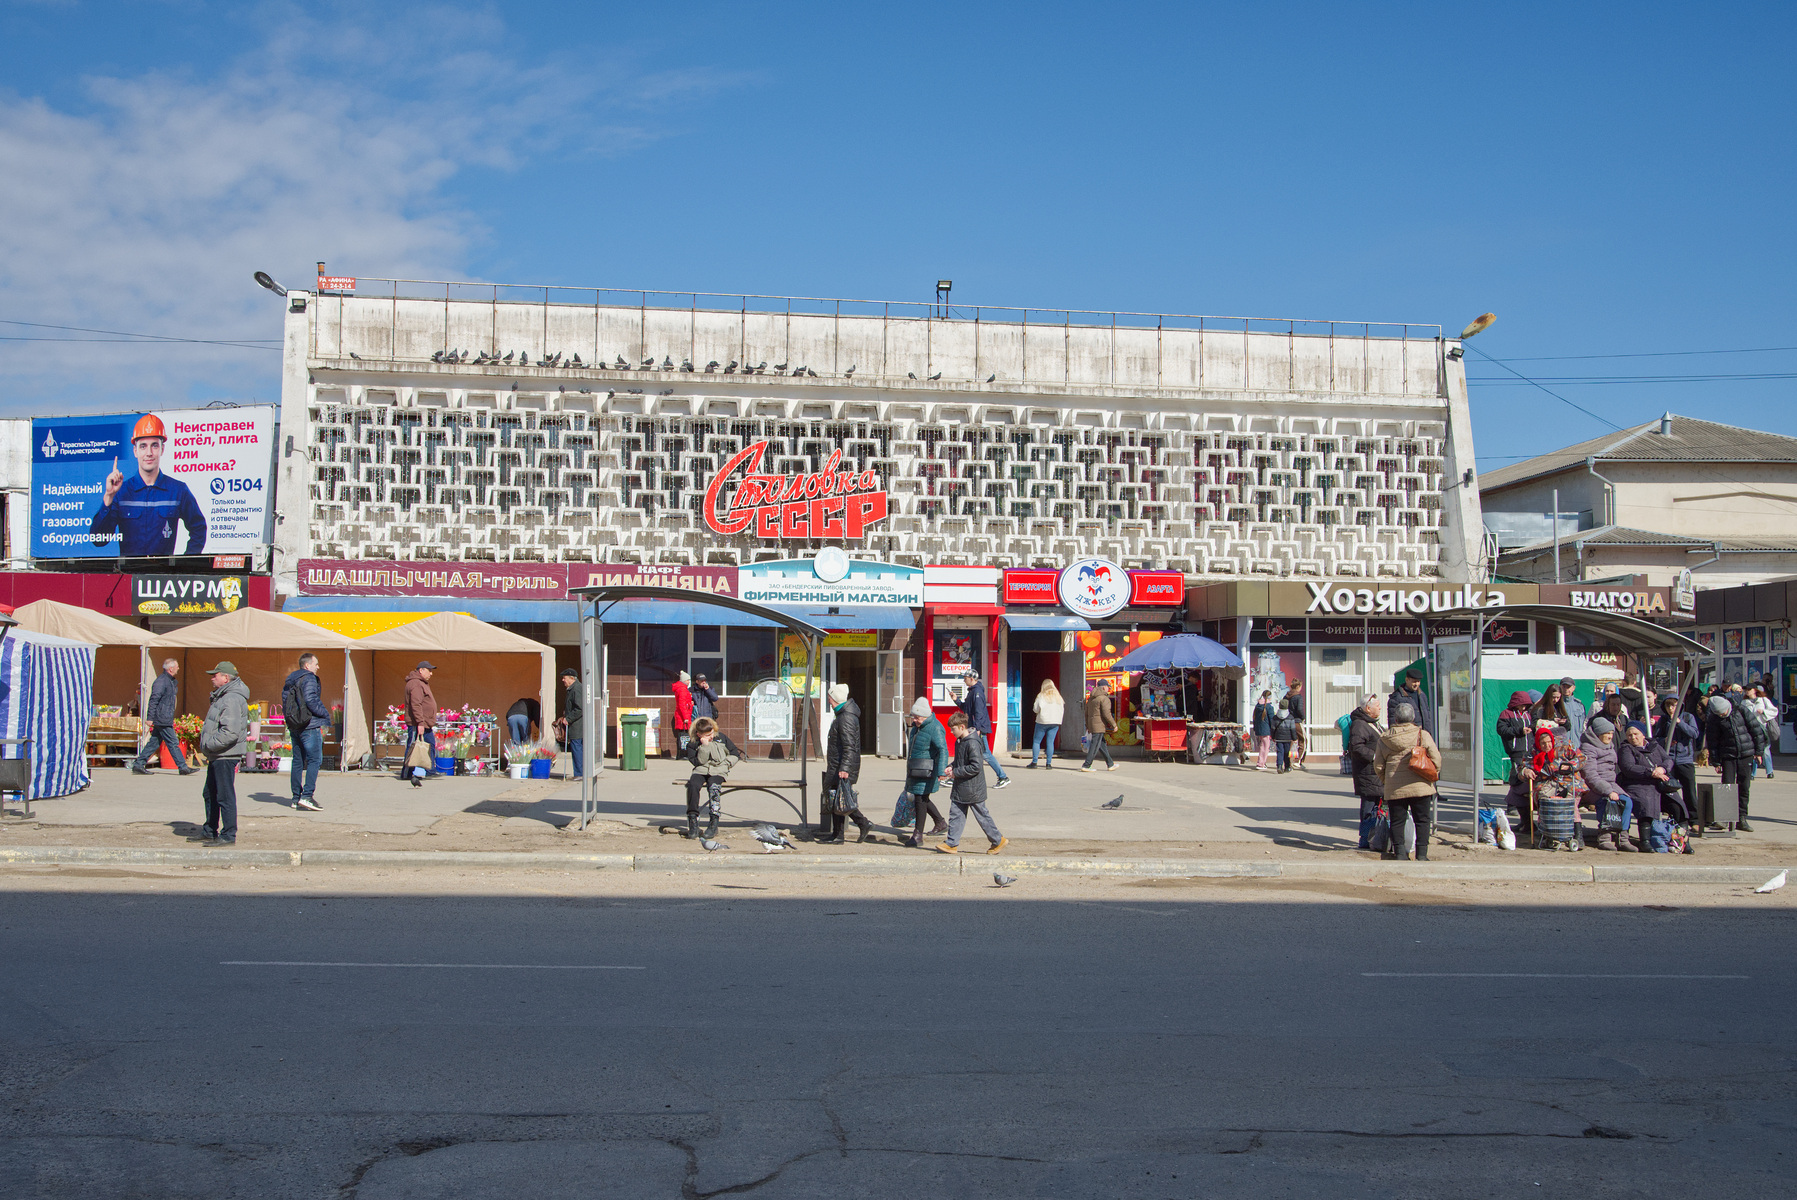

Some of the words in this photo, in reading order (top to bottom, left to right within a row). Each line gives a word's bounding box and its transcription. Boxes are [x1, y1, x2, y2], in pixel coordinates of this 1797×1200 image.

[174, 421, 255, 435] Неисправен
[174, 434, 216, 447] котёл,
[218, 434, 259, 445] плита
[60, 448, 105, 456] Приднестровье
[173, 450, 199, 460] или
[173, 459, 237, 473] колонка?
[43, 482, 103, 496] Надёжный
[227, 478, 263, 492] 1504
[703, 440, 877, 535] Столовка
[42, 501, 85, 514] ремонт
[757, 490, 888, 539] СССР
[42, 517, 92, 528] газового
[42, 532, 123, 546] оборудования
[210, 531, 260, 539] безопасность!
[637, 565, 682, 575] КАФЕ
[307, 568, 559, 592] ШАШЛЫЧНАЯ-гриль
[138, 579, 243, 598] ШАУРМА
[1009, 583, 1052, 592] ТЕРРИТОРИЯ
[1146, 584, 1175, 593] АЗАРТА
[744, 590, 844, 603] ФИРМЕННЫЙ
[849, 592, 918, 604] МАГАЗИН
[1306, 582, 1506, 614] Хозяюшка
[1570, 590, 1666, 614] БЛАГОДА
[1325, 626, 1401, 635] ФИРМЕННЫЙ
